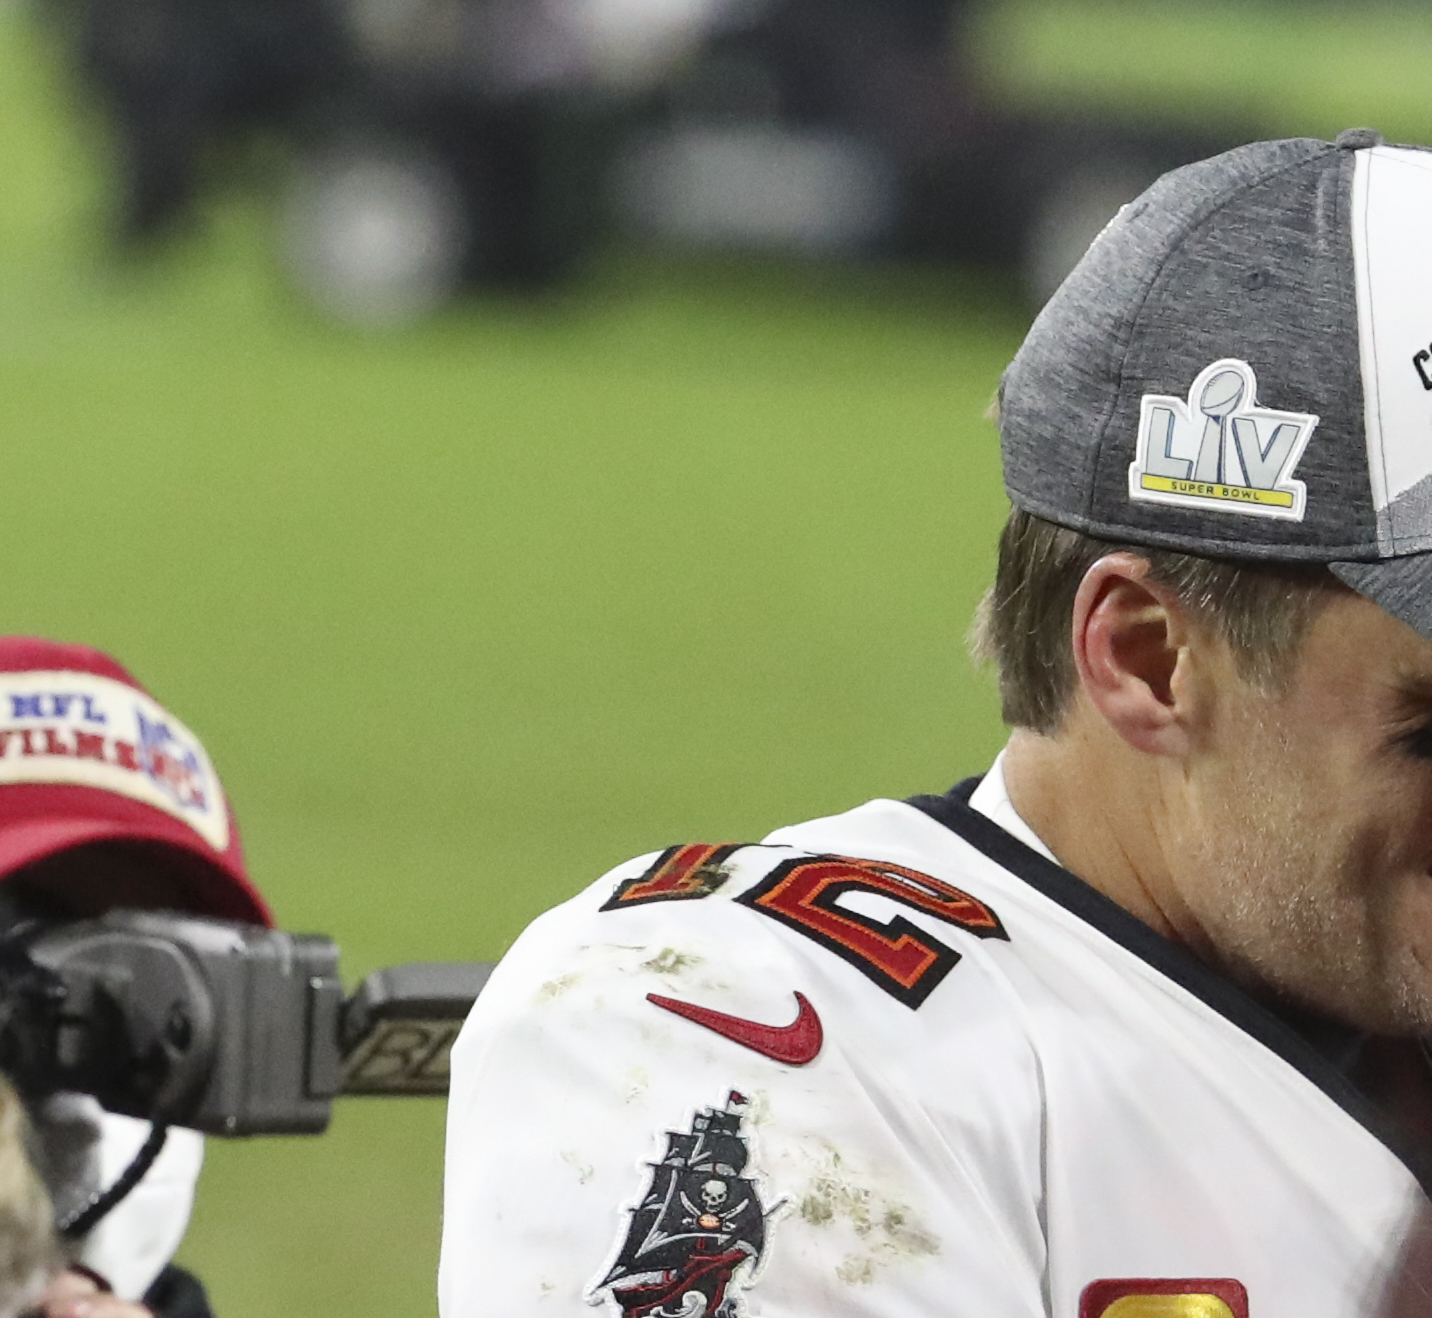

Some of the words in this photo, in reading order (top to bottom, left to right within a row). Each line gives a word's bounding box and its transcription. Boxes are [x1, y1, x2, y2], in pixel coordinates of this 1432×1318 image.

[1146, 407, 1300, 490] LIV
[1171, 481, 1215, 495] SUPER
[1222, 488, 1260, 501] BOWL
[10, 694, 106, 722] NFL
